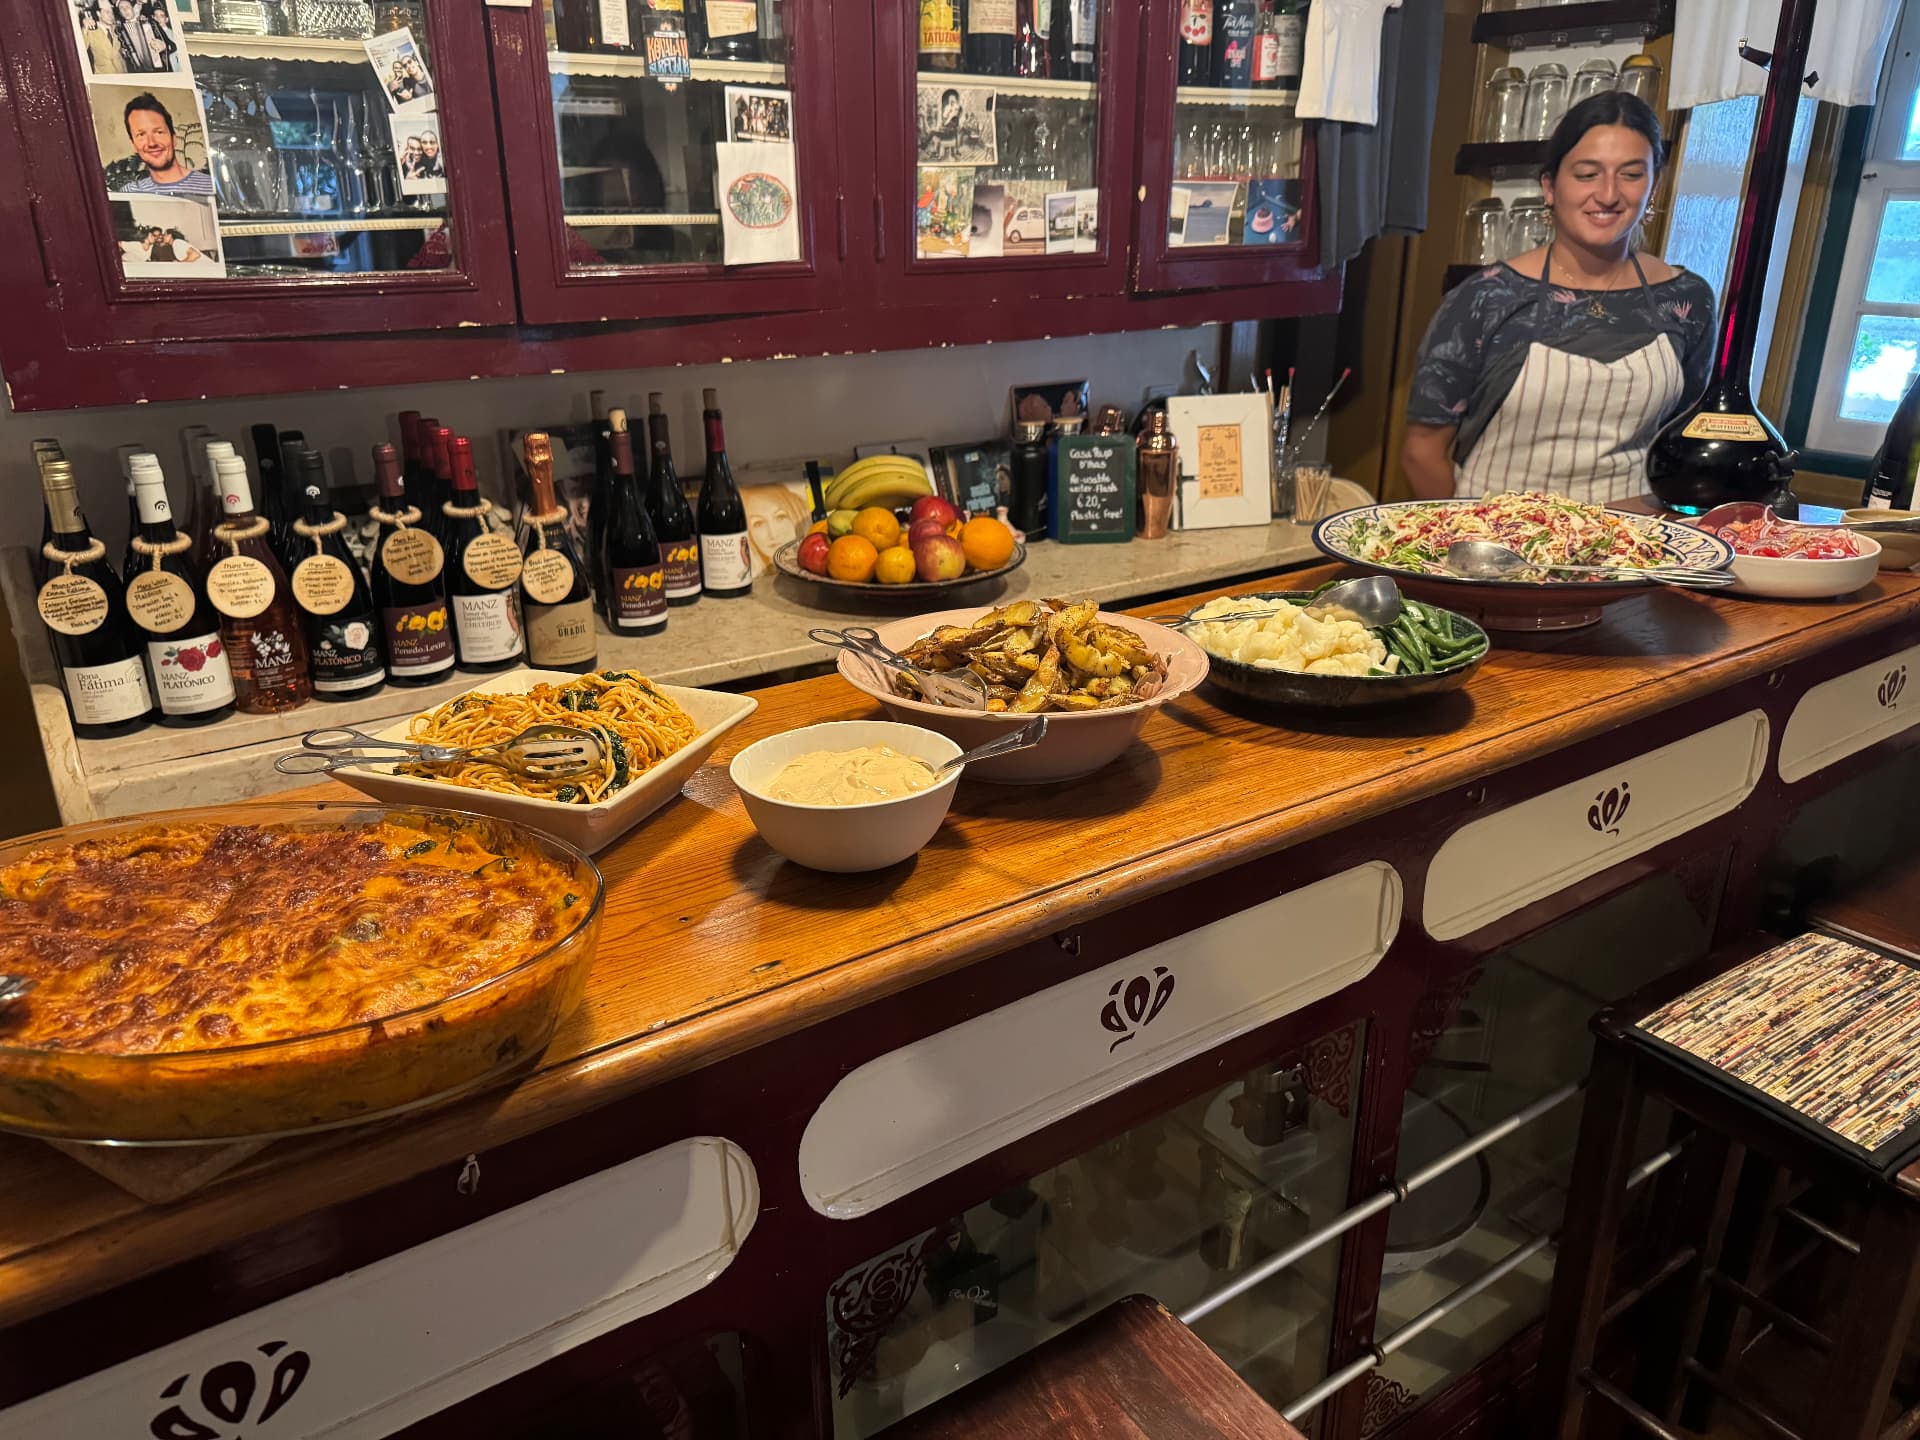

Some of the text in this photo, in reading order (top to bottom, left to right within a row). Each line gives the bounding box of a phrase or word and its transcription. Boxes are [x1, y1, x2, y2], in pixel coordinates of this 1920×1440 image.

[1069, 448, 1092, 458] Casa
[462, 600, 498, 611] MANZ
[393, 638, 418, 647] MANZ
[313, 649, 339, 657] MANZ
[255, 653, 294, 668] MANZ
[77, 673, 99, 681] Dona
[161, 672, 189, 681] MANZ
[79, 677, 125, 691] Fátima
